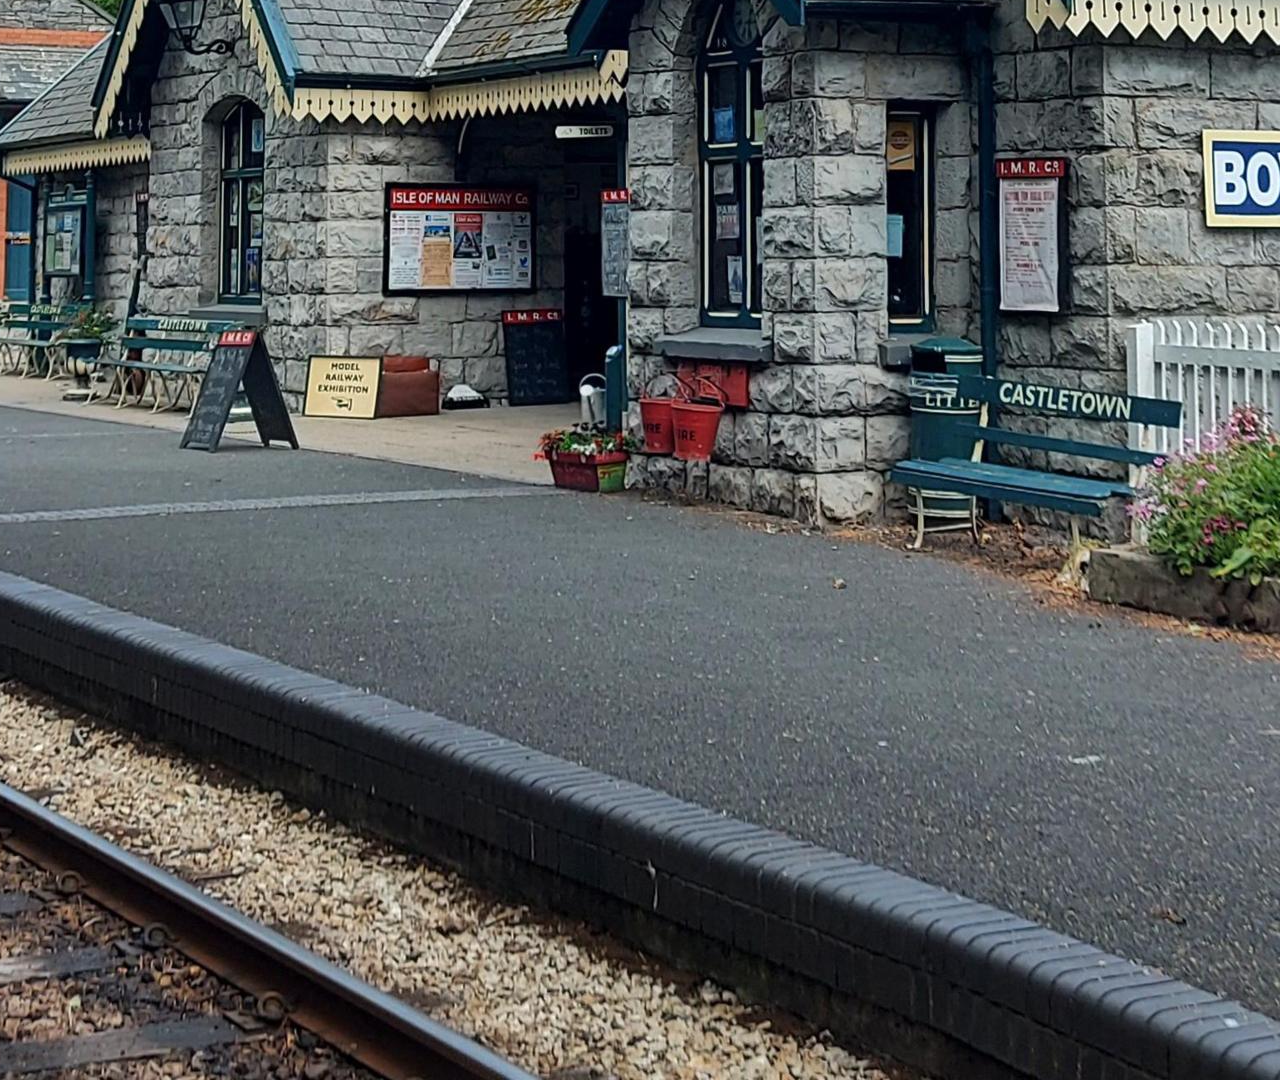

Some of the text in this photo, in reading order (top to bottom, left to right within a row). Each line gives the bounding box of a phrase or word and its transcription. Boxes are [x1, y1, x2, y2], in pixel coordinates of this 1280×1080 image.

[579, 127, 609, 136] TOILETS
[392, 191, 417, 204] ISLE
[418, 191, 433, 204] OF
[435, 192, 460, 204] MAN
[463, 192, 513, 205] RAILWAY
[158, 319, 208, 331] CASTLETOWN
[330, 362, 361, 371] MODEL
[325, 373, 364, 382] RAILWAY
[317, 384, 369, 394] EXHIBITION
[998, 381, 1133, 420] CASTLETOWN
[645, 423, 662, 434] IRE
[677, 430, 697, 441] IRE
